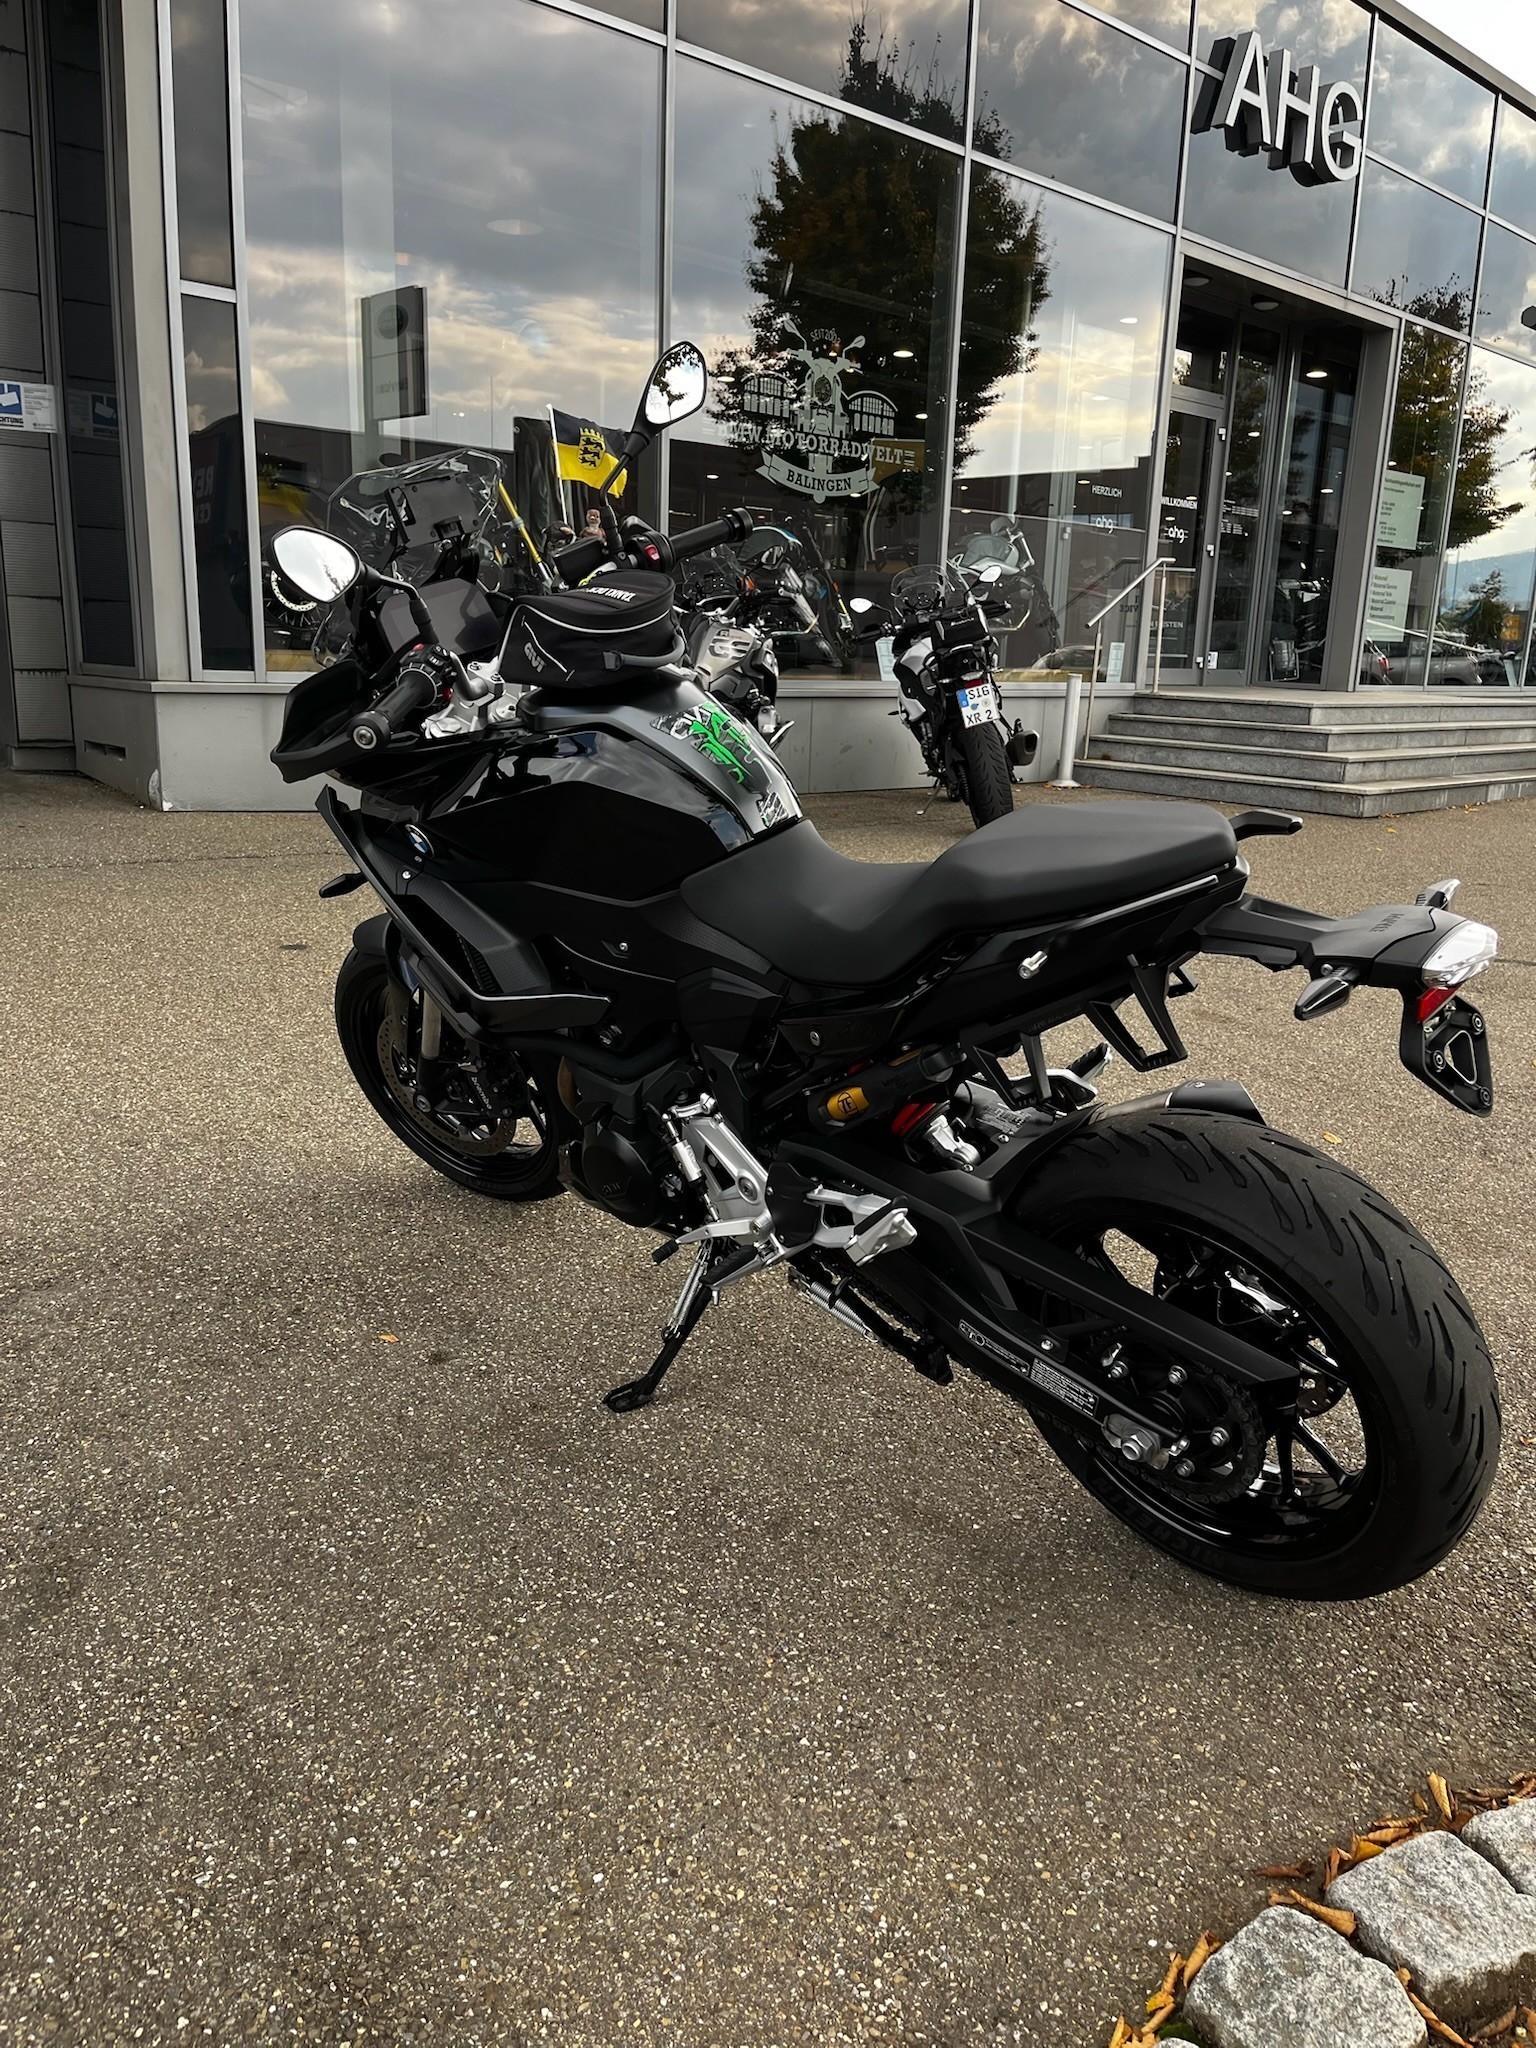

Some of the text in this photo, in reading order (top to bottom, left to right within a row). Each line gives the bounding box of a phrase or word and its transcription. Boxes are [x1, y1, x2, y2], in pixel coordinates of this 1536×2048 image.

[1216, 30, 1364, 181] AHG
[810, 328, 825, 342] SEIT
[765, 425, 904, 465] MOTORRADWELT
[786, 468, 852, 491] BALINGEN
[1092, 485, 1123, 498] HERZLICH
[1161, 496, 1198, 510] WILLKOMMEN
[1096, 516, 1113, 534] ahg
[1168, 526, 1185, 543] ahg
[524, 642, 546, 673] GIVI
[968, 685, 990, 700] SIG
[967, 709, 993, 725] XR 2
[471, 1076, 492, 1110] brembo
[1091, 1476, 1227, 1568] MICHELIN
